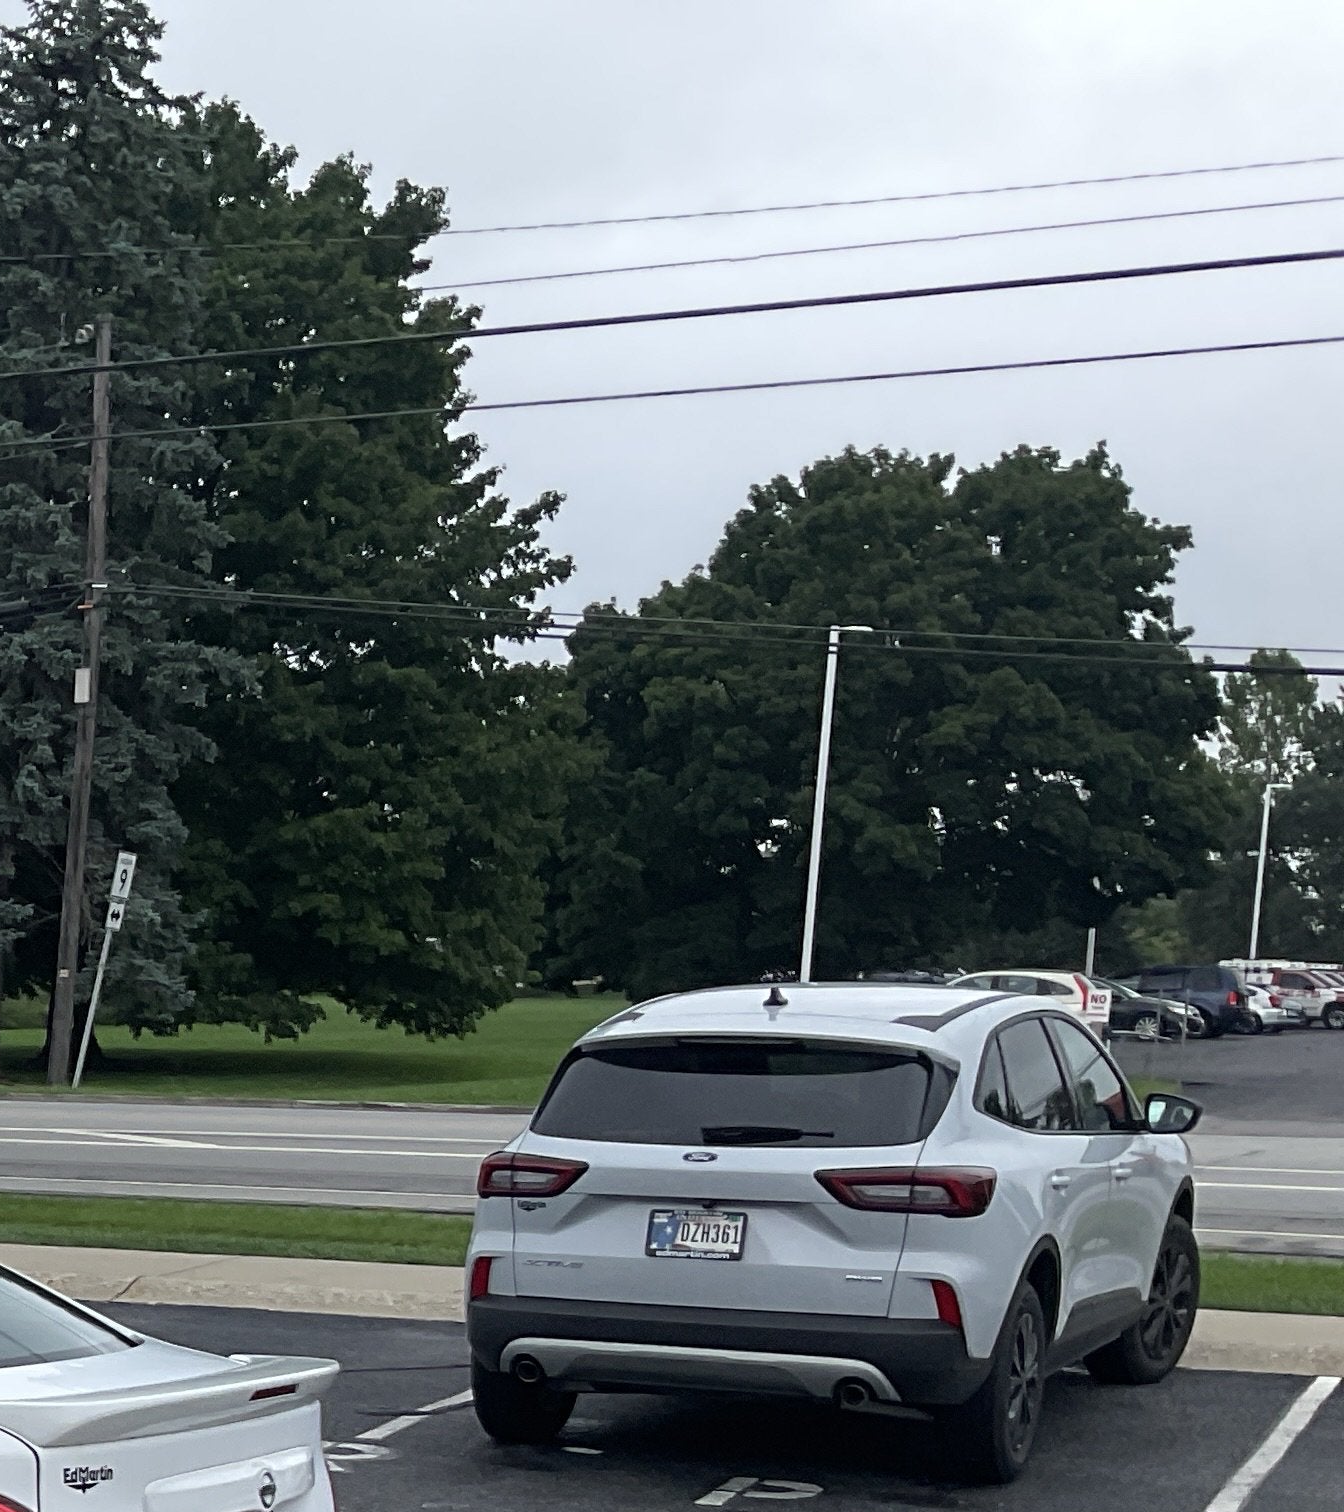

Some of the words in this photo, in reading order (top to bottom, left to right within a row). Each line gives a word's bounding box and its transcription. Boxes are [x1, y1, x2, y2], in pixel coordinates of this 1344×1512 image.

[119, 868, 128, 892] 9
[1090, 994, 1108, 1005] NO
[679, 1222, 741, 1244] DZH361
